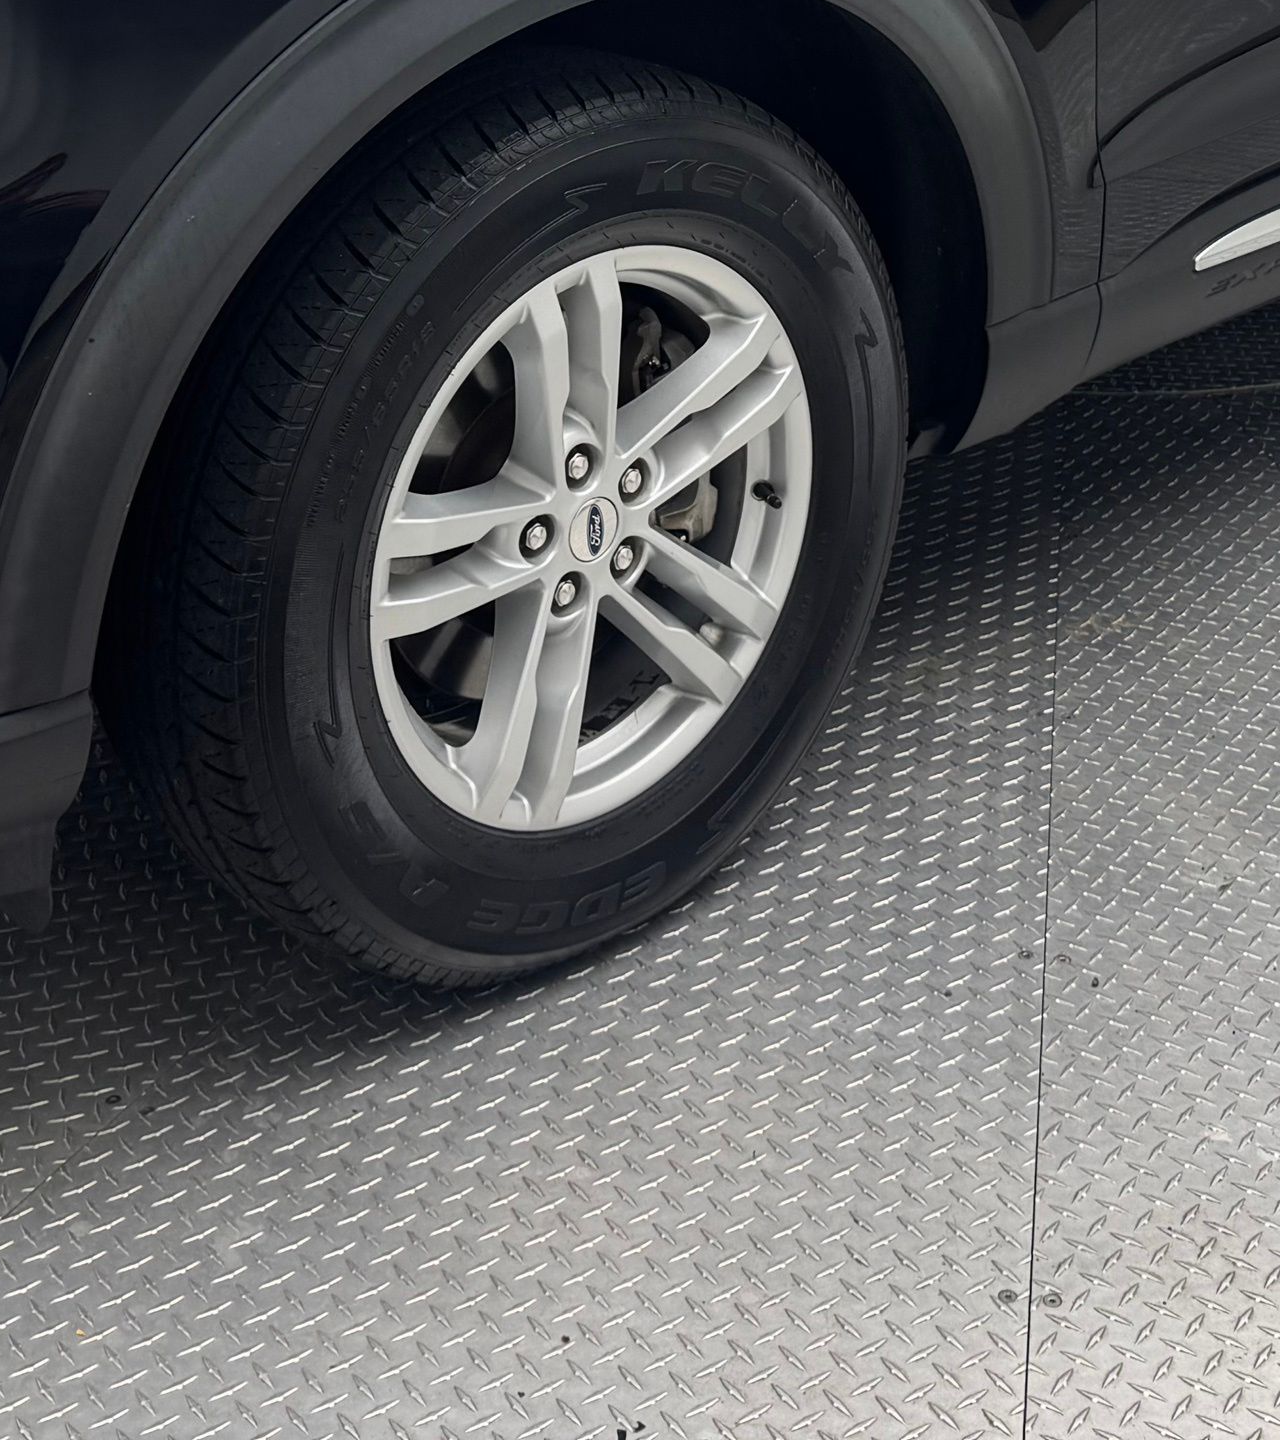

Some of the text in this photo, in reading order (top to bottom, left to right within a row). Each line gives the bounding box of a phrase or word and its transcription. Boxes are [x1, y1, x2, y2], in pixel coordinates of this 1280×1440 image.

[636, 159, 855, 274] KELLY
[589, 514, 602, 547] Ford
[466, 860, 667, 935] EDGE
